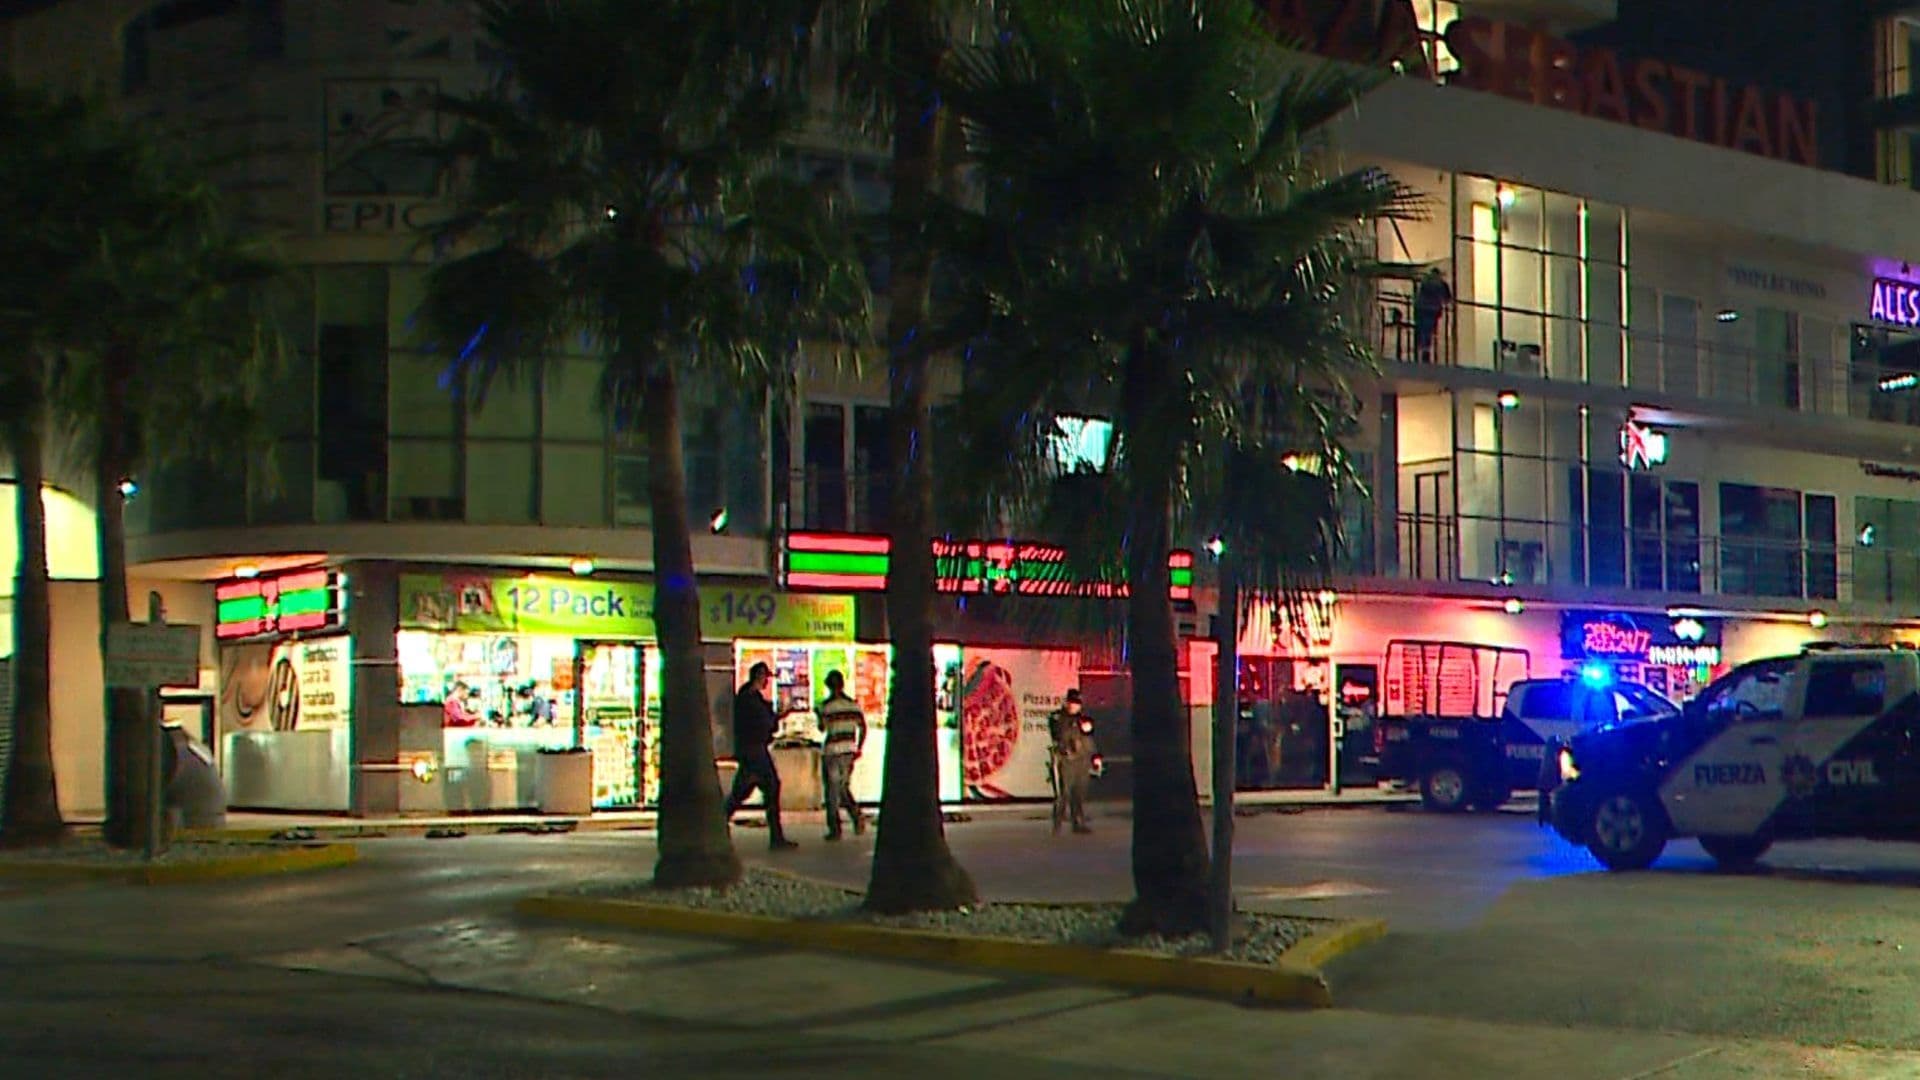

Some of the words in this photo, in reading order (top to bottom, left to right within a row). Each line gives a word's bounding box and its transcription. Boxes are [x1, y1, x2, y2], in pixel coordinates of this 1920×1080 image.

[507, 586, 541, 614] 12
[550, 588, 625, 617] Pack
[1694, 763, 1767, 785] FUERZA
[1828, 760, 1879, 785] CIVIL
